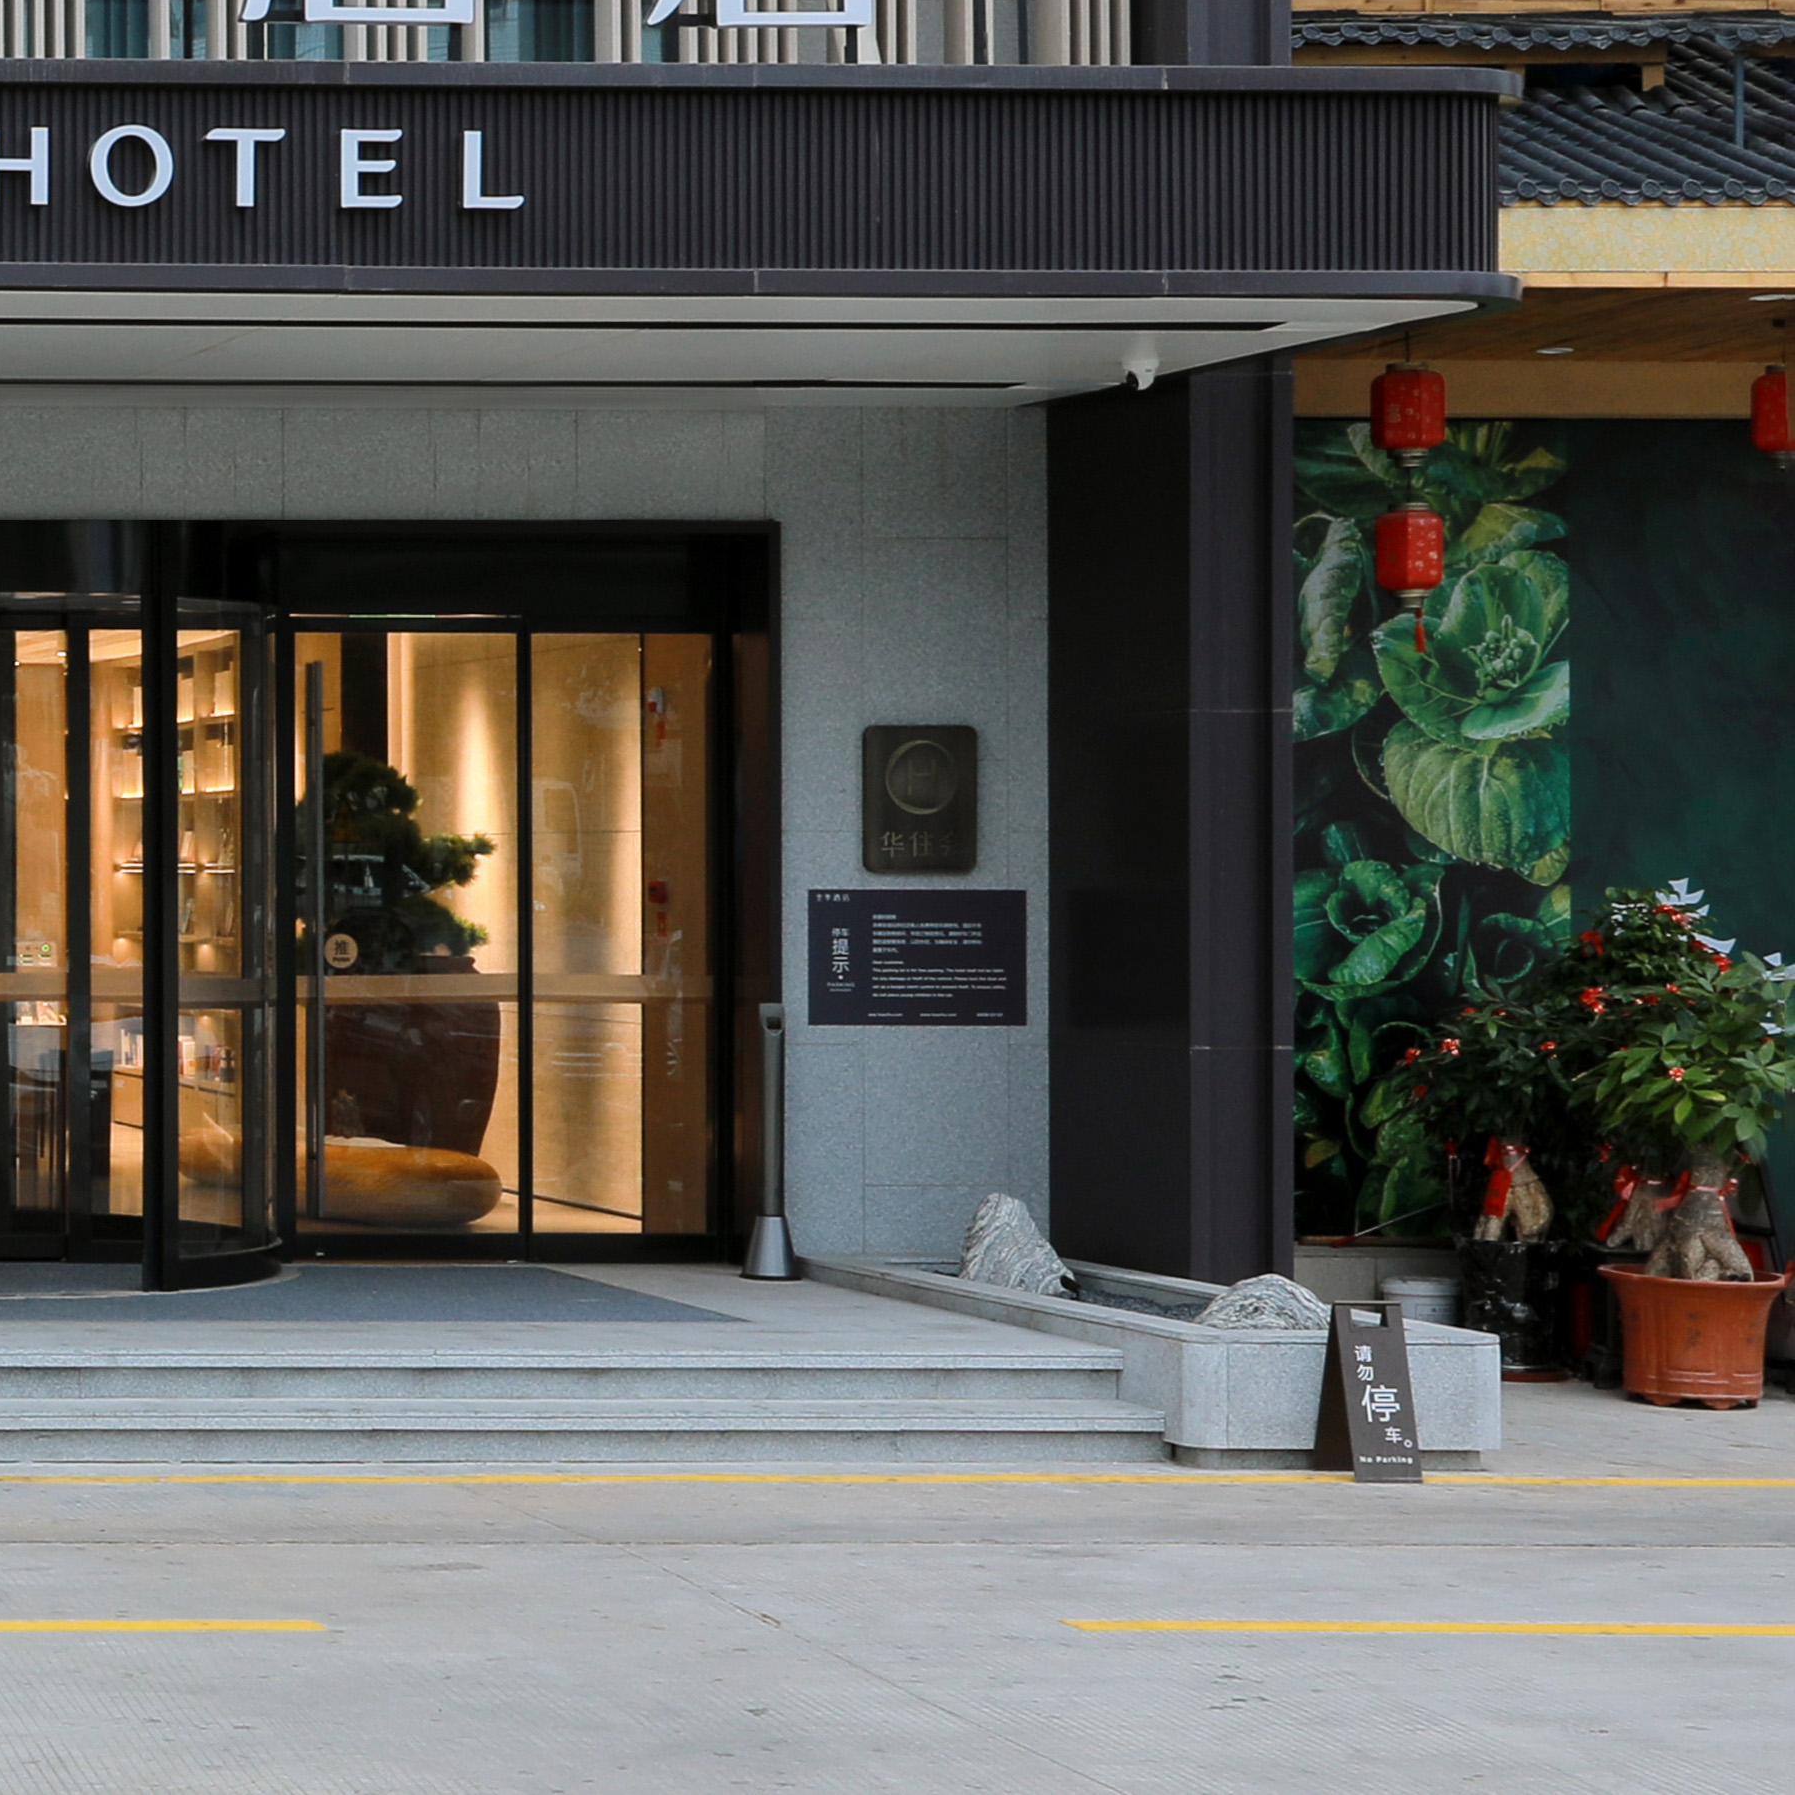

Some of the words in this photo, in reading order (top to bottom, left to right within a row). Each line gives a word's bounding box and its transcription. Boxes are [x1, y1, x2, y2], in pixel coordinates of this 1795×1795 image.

[832, 938, 849, 973] 提示
[1359, 1455, 1373, 1463] No
[1375, 1455, 1413, 1465] Parking
